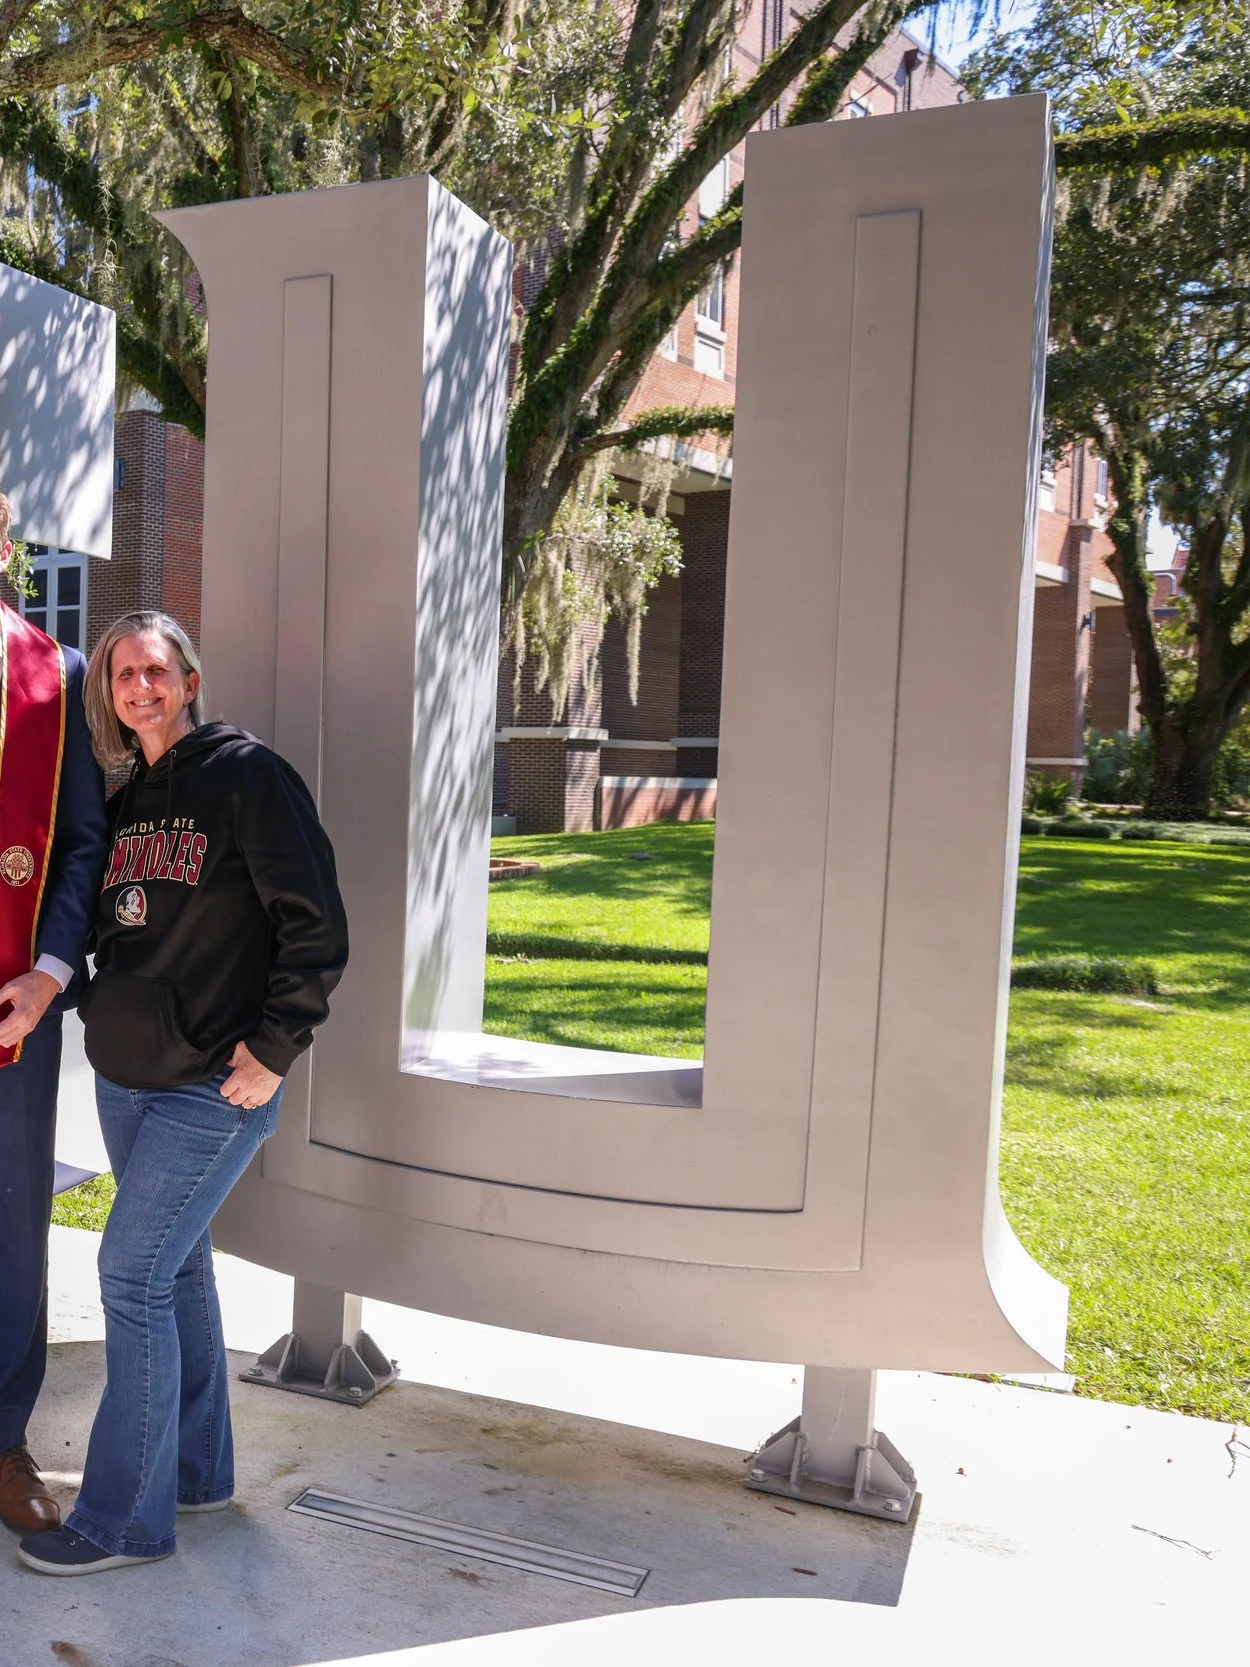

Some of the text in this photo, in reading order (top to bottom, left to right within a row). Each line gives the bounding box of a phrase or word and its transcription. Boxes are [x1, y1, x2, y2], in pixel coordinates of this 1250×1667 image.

[114, 817, 195, 839] LORIDA SATE
[101, 830, 208, 893] MINOLES
